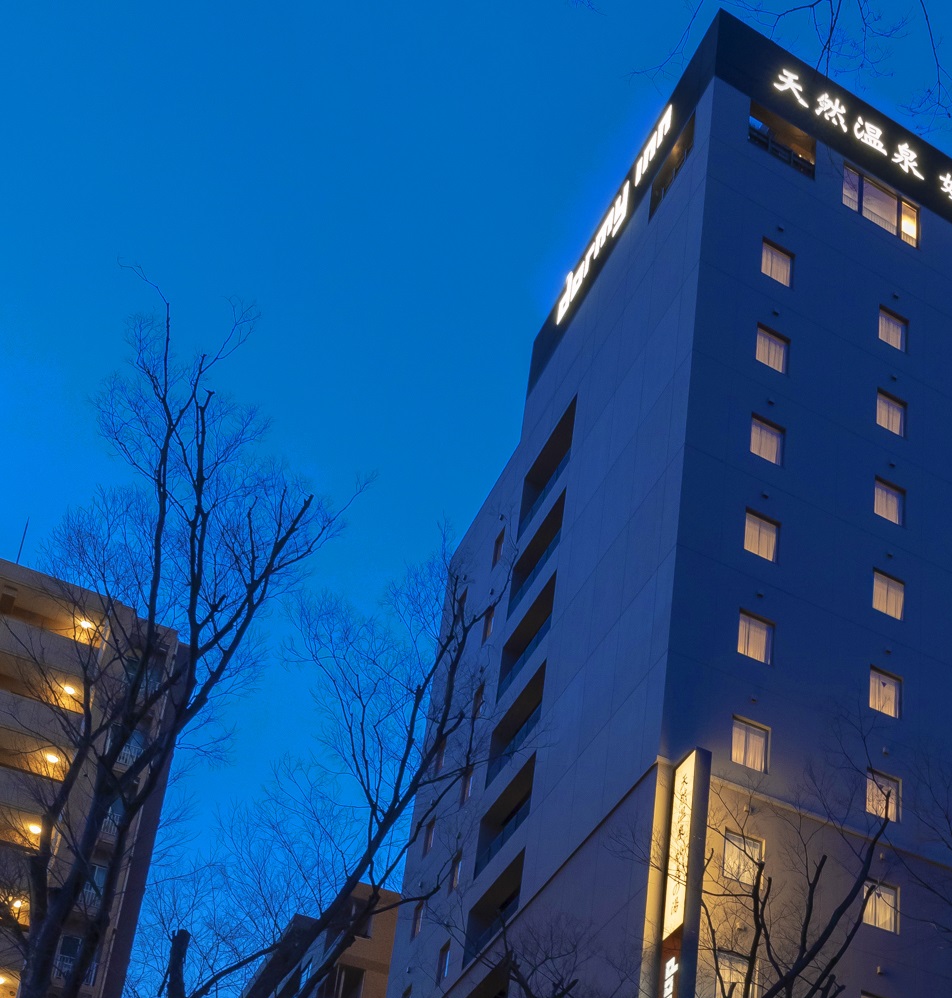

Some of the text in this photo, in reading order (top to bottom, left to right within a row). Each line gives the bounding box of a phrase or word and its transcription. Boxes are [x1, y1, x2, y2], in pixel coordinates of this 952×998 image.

[773, 68, 925, 181] 天然温泉
[556, 104, 673, 326] dormy inn
